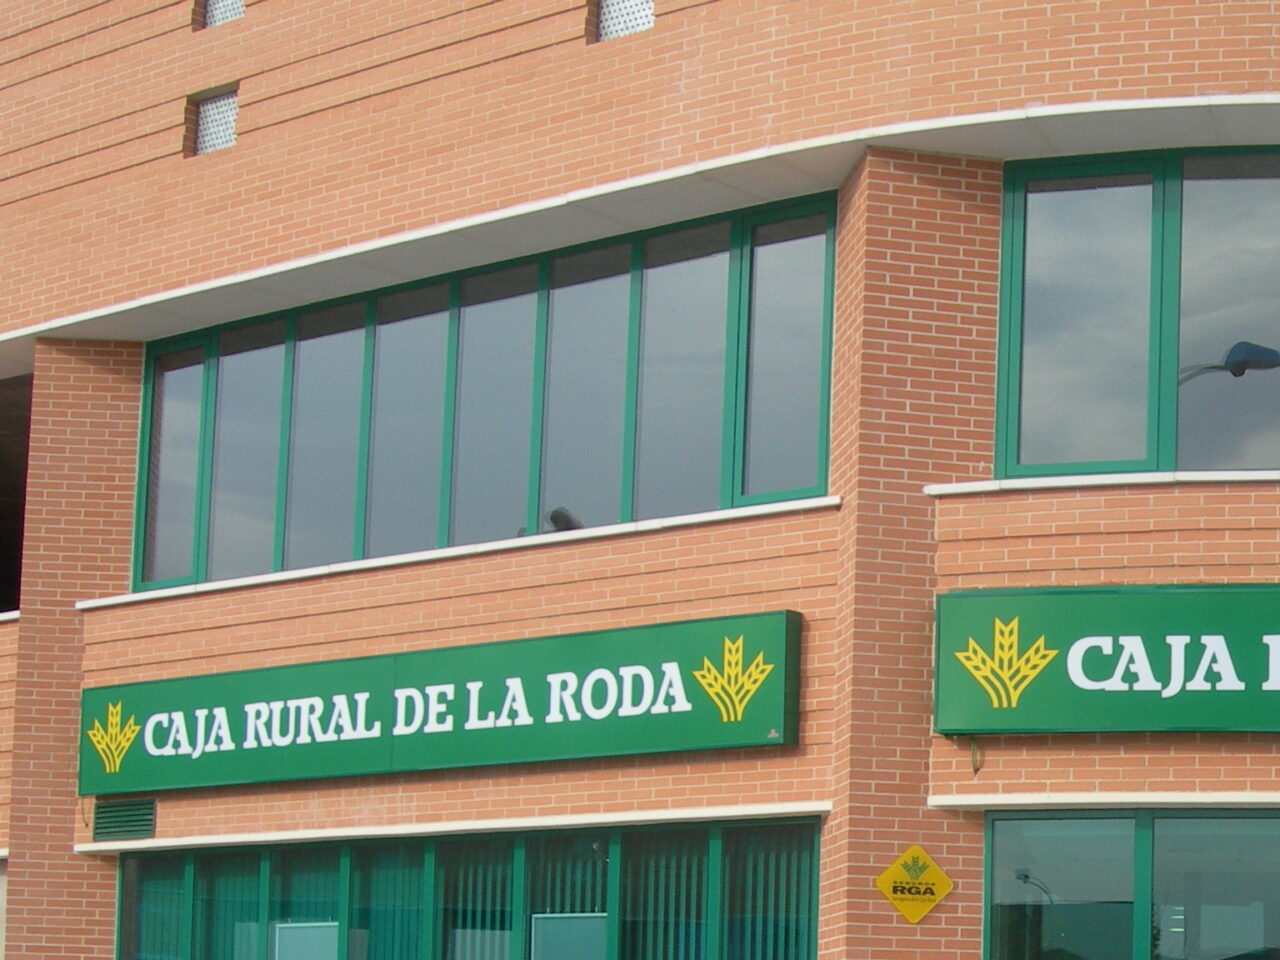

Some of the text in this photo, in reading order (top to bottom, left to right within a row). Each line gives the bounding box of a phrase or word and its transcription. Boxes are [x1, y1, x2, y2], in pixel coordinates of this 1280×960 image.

[1066, 634, 1246, 698] CAJA
[143, 661, 693, 759] CAJA RURAL DE LA RODA
[892, 885, 936, 897] RGA
